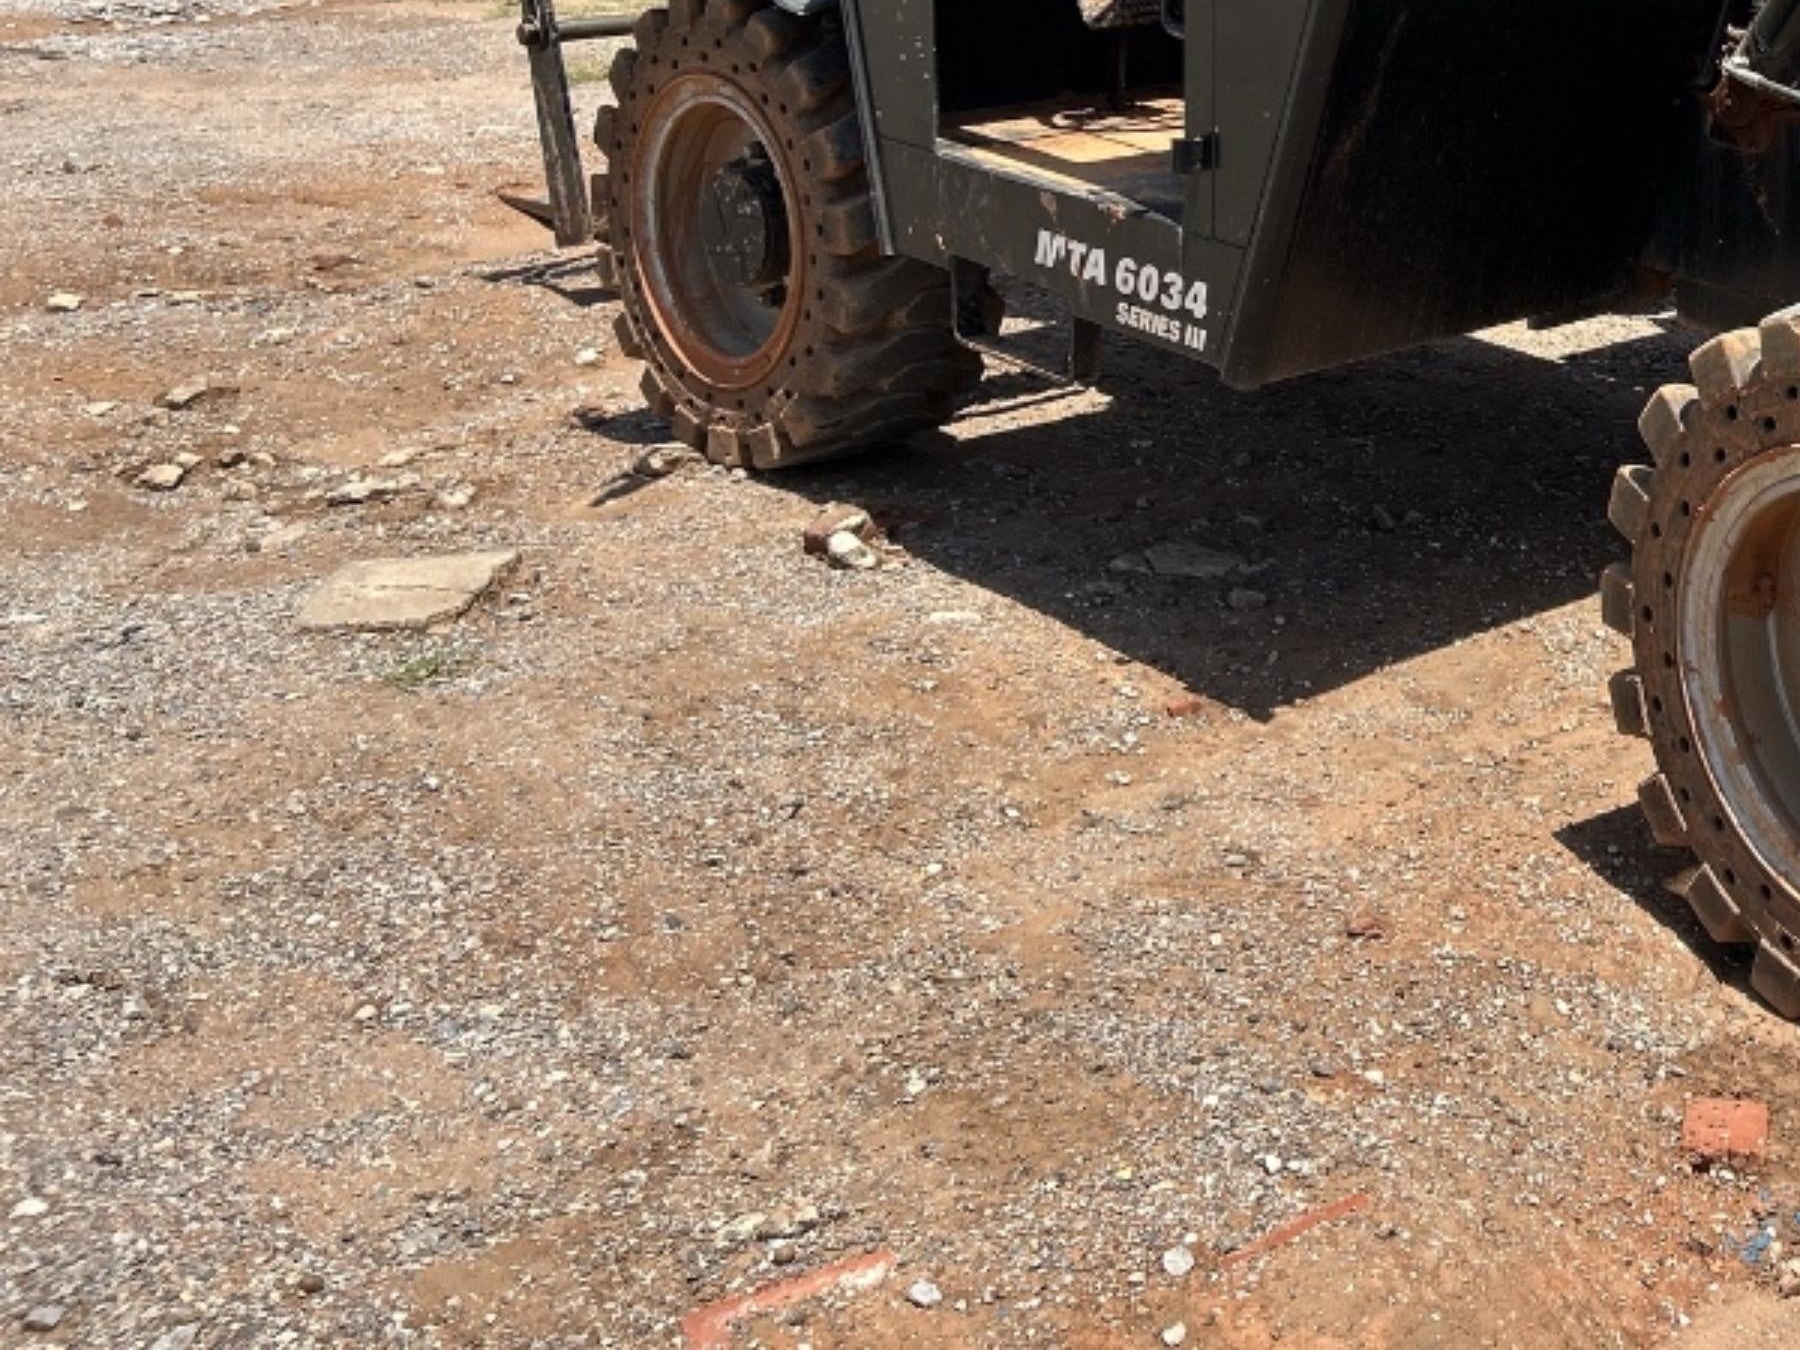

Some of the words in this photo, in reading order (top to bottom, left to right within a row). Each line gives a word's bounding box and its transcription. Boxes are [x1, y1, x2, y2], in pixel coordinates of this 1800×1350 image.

[1034, 227, 1107, 287] MTA
[1115, 257, 1208, 320] 6034
[1115, 302, 1181, 343] SERIES
